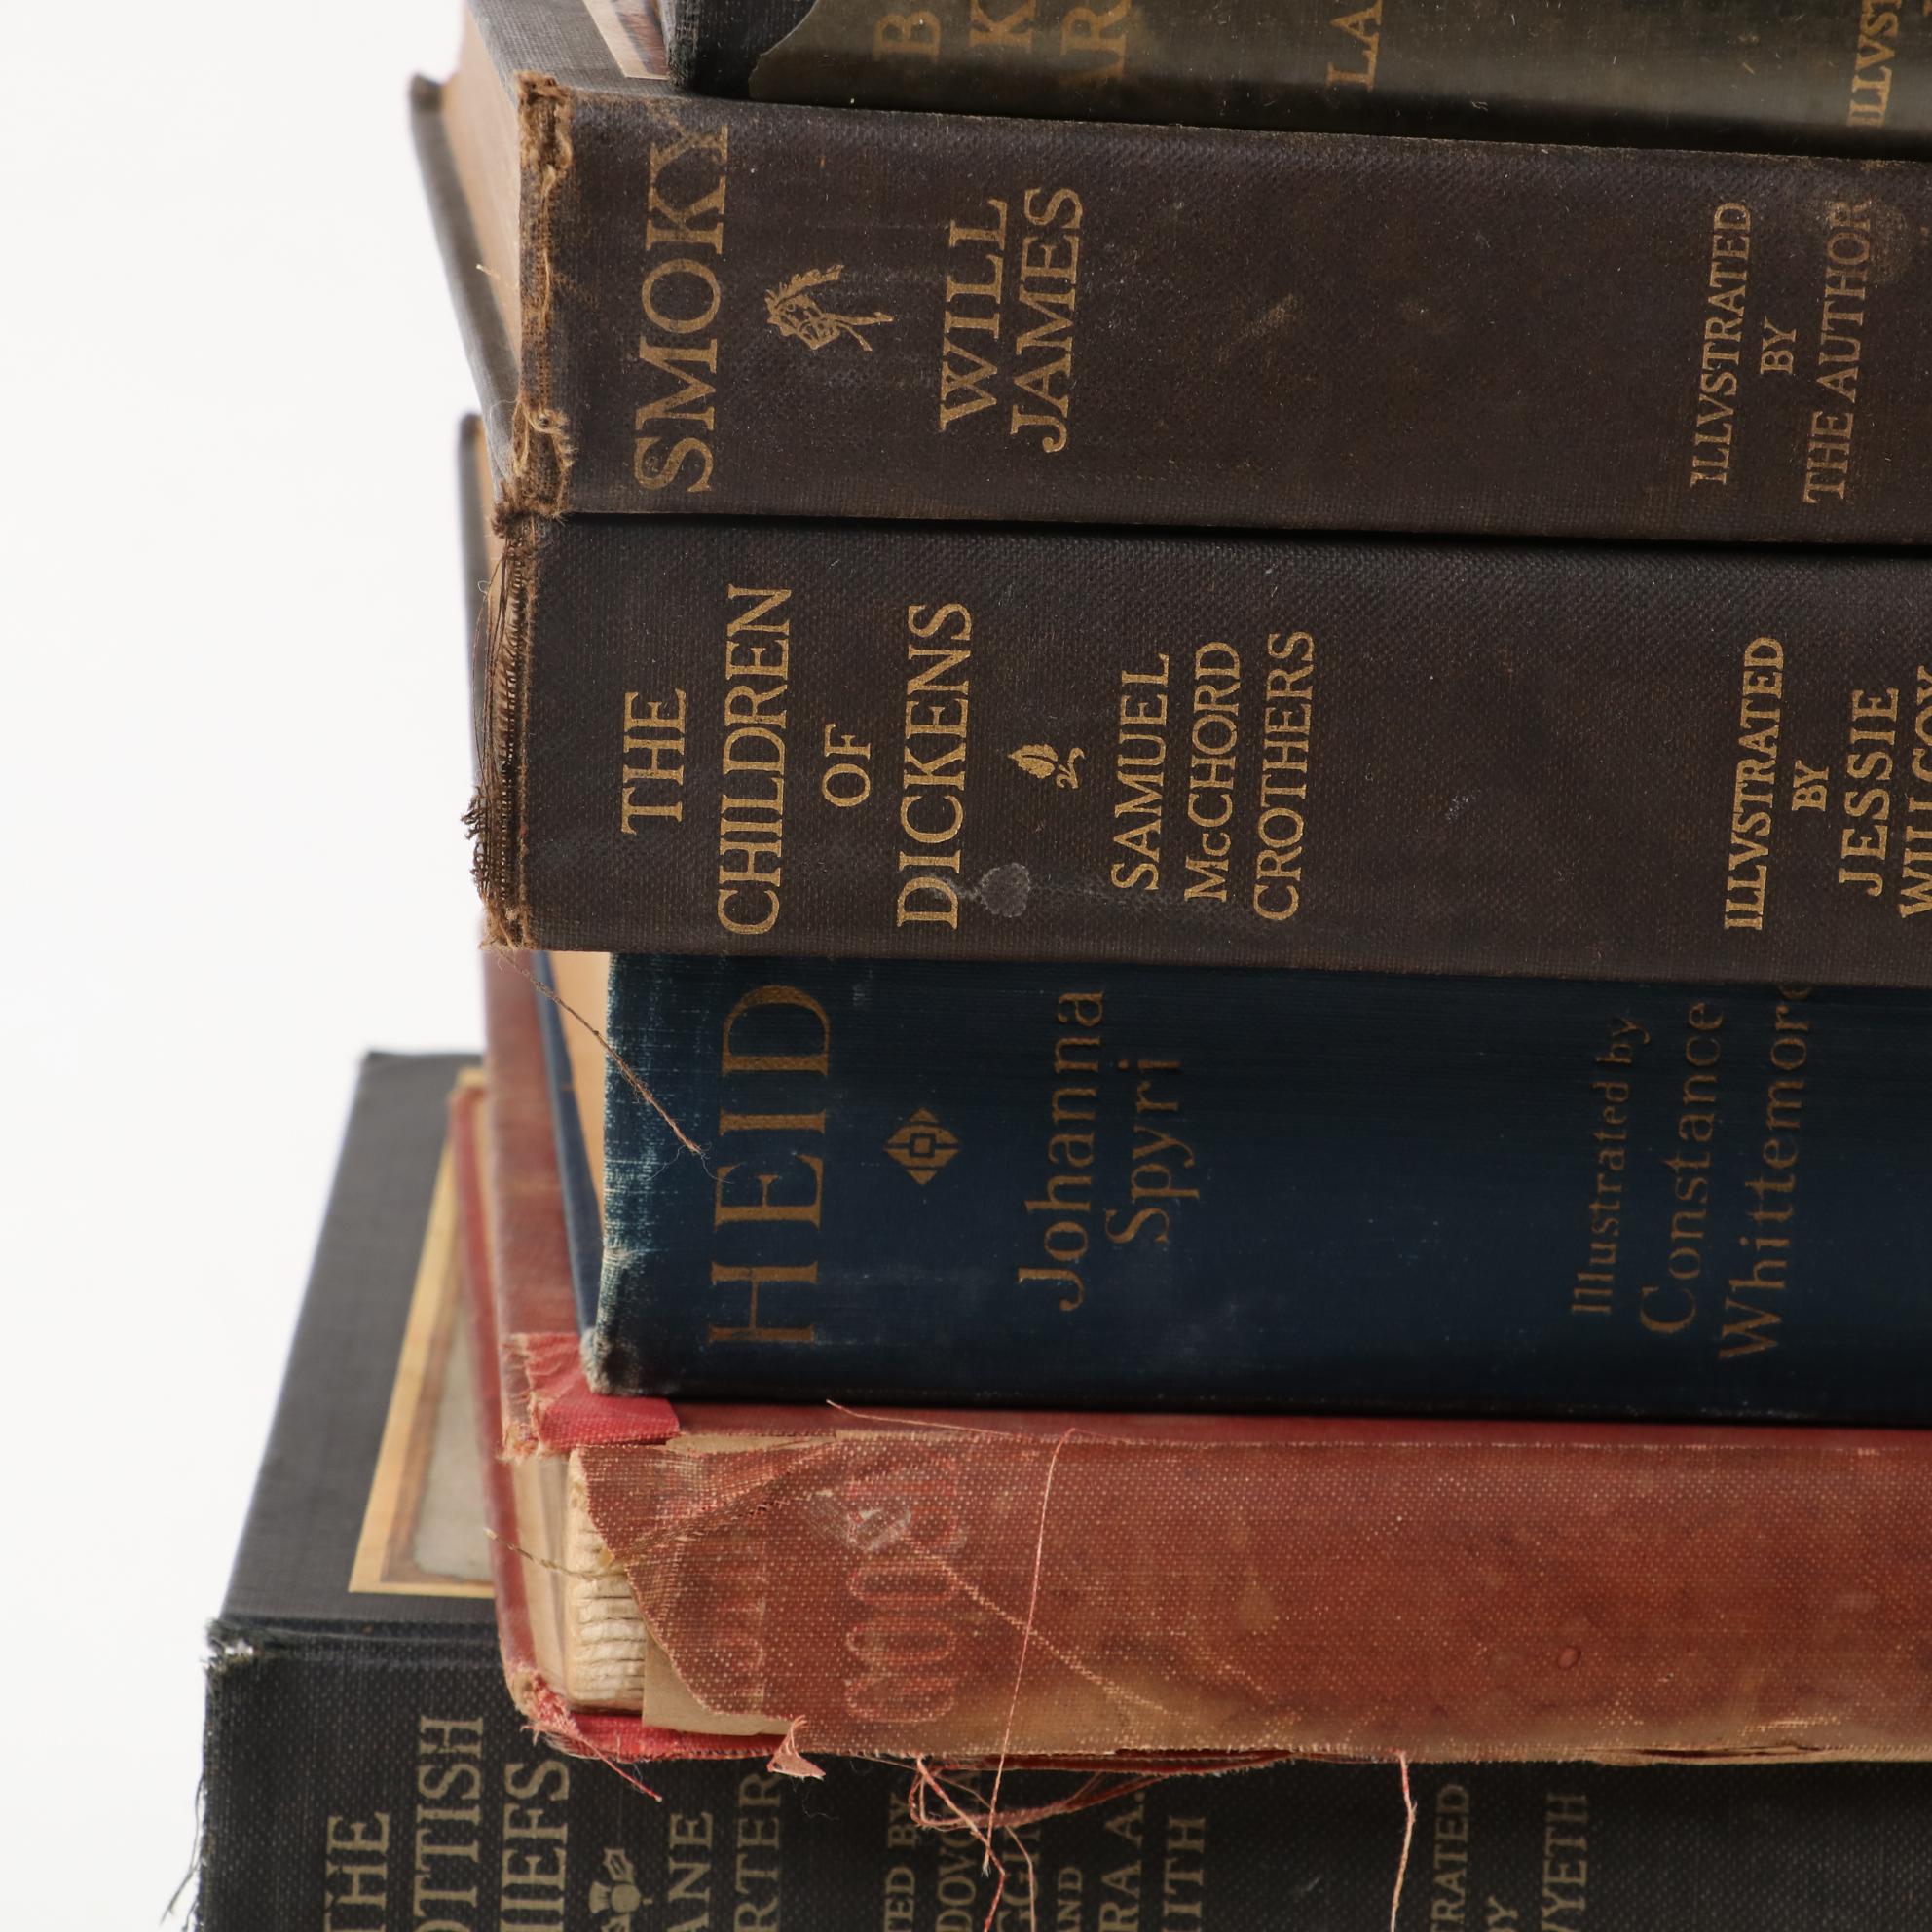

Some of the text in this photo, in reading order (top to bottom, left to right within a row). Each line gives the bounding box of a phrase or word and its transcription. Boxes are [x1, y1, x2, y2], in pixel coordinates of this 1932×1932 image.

[633, 107, 730, 494] SMOKY
[939, 197, 1008, 432] WILL
[1009, 186, 1084, 455] JAMES
[1690, 201, 1752, 488] ILLVSTRATED
[1759, 316, 1797, 375] BY
[1802, 198, 1873, 504] THE AUTHOR
[620, 687, 687, 836] THE
[716, 583, 793, 936] CHILDREN
[820, 722, 873, 809] OF
[895, 602, 975, 931] DICKENS
[1109, 652, 1171, 892] SAMUEL
[1183, 640, 1242, 904] McCHORD
[1252, 630, 1317, 922] CROTHERS
[1724, 636, 1785, 931] ILLVSTRATED
[1791, 760, 1830, 812] BY
[1838, 687, 1900, 897] JESSIE
[1017, 989, 1105, 1312] Johanna
[1105, 1059, 1201, 1245] Spyri
[1570, 1016, 1652, 1315] Illustrated by
[1638, 1000, 1725, 1335] Constance
[413, 1714, 485, 1932] TTISH
[500, 1759, 570, 1932] IEFS
[886, 1791, 919, 1850] BY
[1054, 1865, 1082, 1932] ND
[1160, 1814, 1207, 1932] ITH
[1541, 1792, 1589, 1932] YETH
